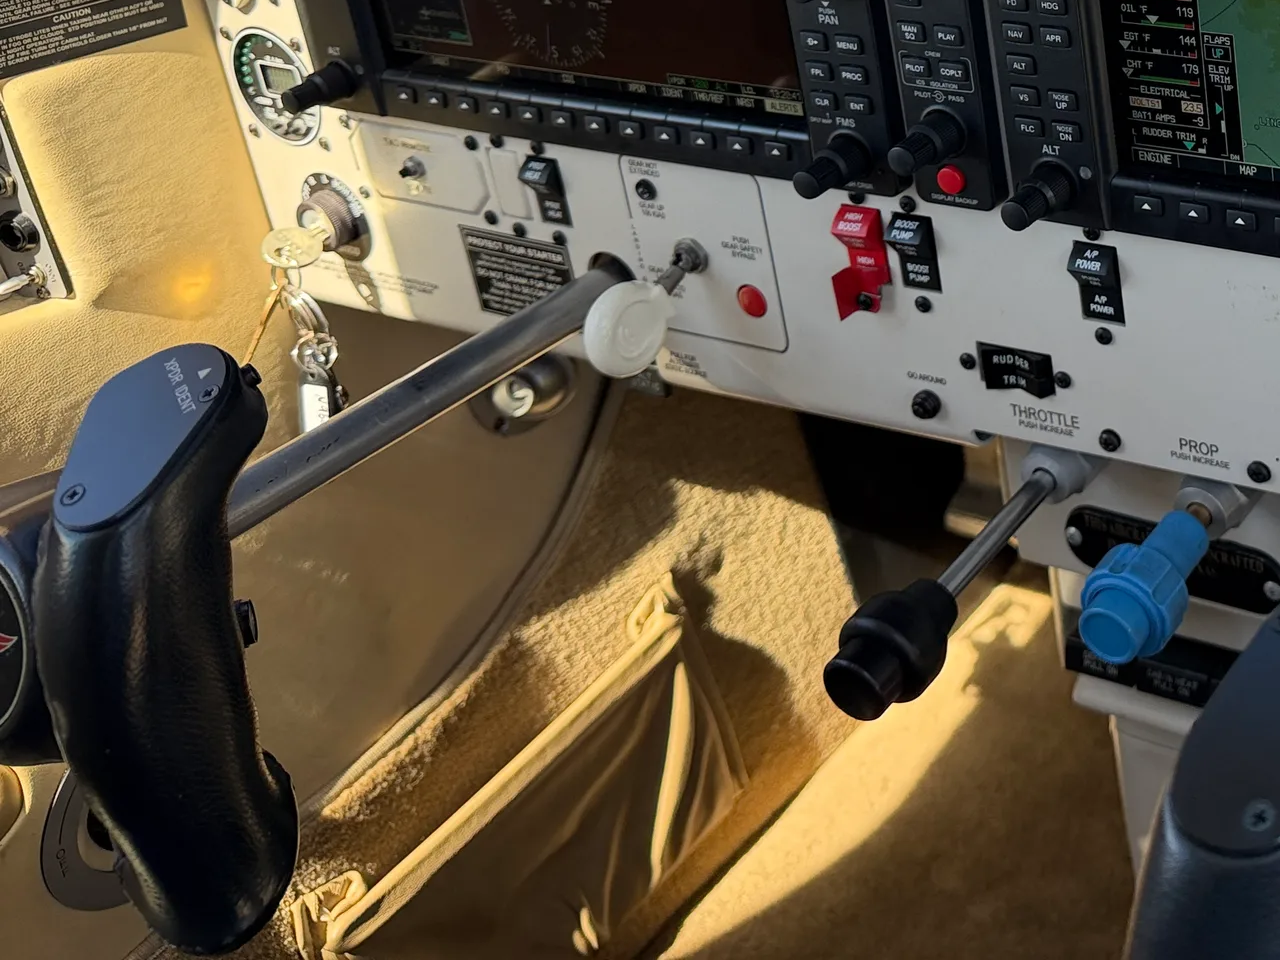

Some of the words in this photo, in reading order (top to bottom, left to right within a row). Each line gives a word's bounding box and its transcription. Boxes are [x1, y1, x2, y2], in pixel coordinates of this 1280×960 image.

[1041, 2, 1058, 10] HDG
[52, 7, 91, 23] CAUTION
[1176, 8, 1194, 18] 119
[1179, 36, 1196, 46] 144
[1204, 35, 1230, 45] FLAPS
[1211, 48, 1224, 58] UP
[1182, 64, 1199, 74] 179
[1042, 145, 1060, 155] ALT
[1139, 152, 1172, 165] ENGINE
[891, 230, 914, 239] PUMP
[1075, 259, 1101, 271] POWER
[164, 358, 181, 387] XPDR
[175, 383, 196, 414] IDENT
[1010, 403, 1080, 429] THROTTLE
[1179, 438, 1219, 456] PROP
